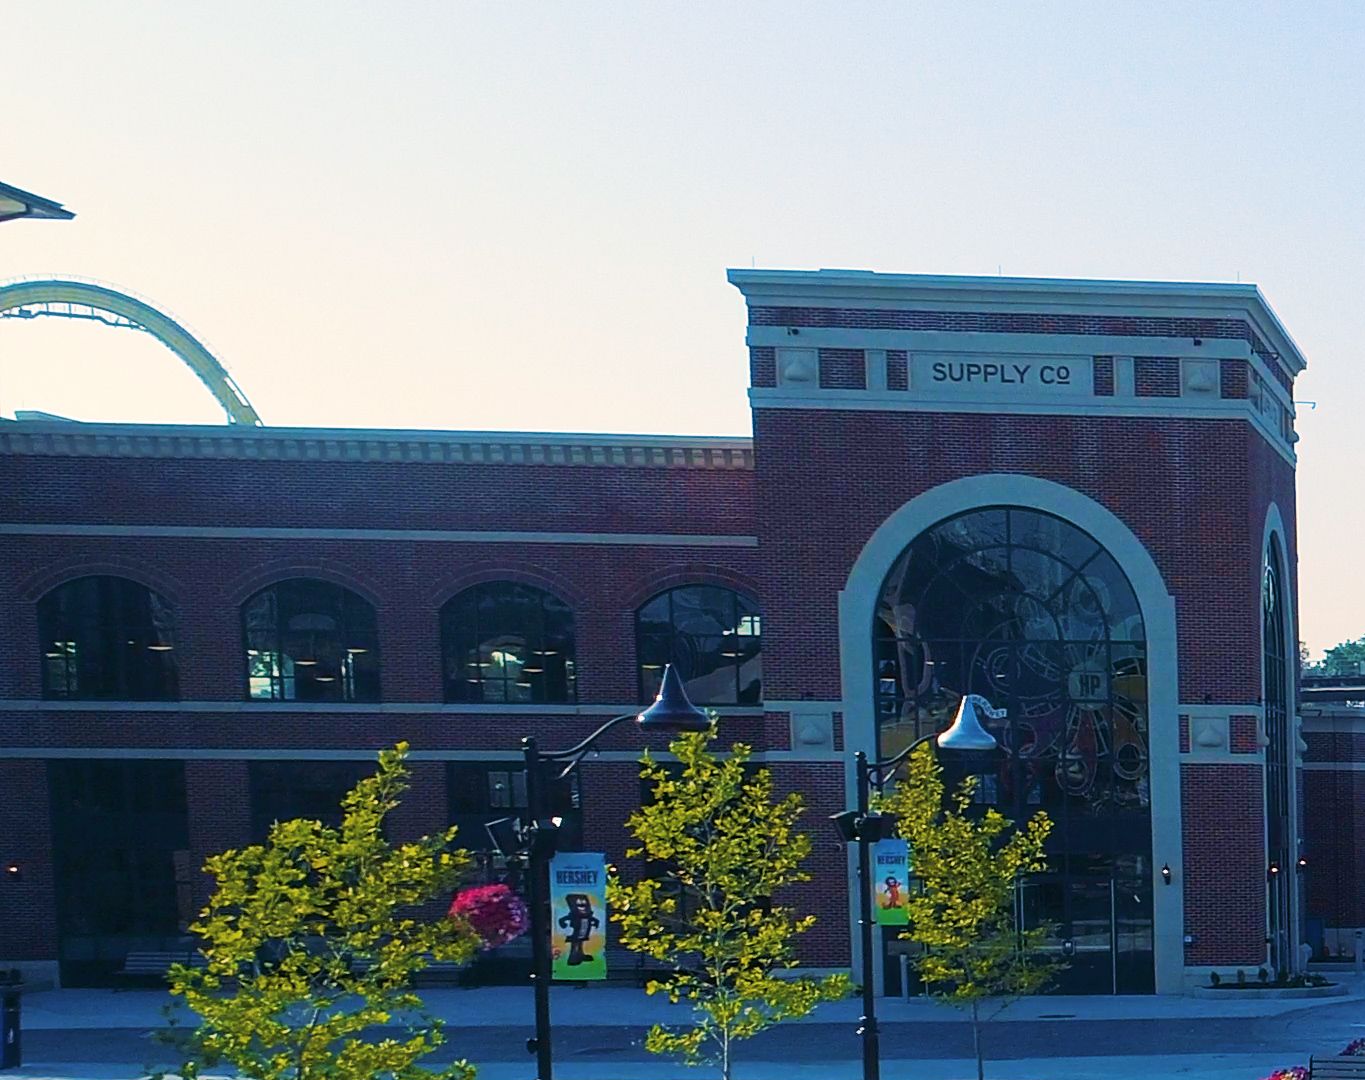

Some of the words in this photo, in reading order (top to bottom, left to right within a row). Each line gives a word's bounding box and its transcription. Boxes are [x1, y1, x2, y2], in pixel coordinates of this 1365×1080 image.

[932, 362, 1031, 384] SUPPLY
[1079, 674, 1100, 697] HP
[556, 870, 599, 884] HERSHEY
